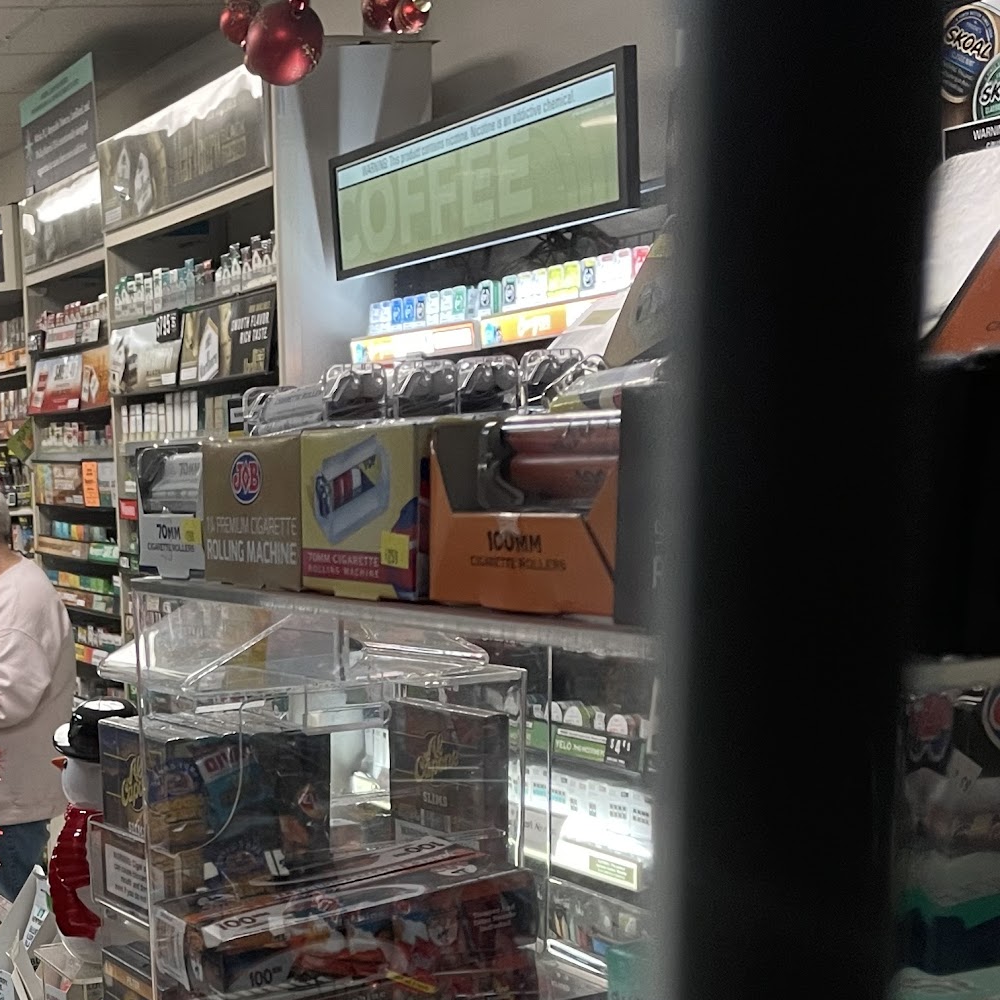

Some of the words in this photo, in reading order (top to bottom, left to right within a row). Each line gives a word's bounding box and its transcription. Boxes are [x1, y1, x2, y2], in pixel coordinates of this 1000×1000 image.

[944, 26, 992, 62] SKOAL
[231, 460, 260, 496] JOB
[156, 523, 180, 540] 70MM
[216, 517, 250, 536] PREMIUM
[250, 516, 298, 537] CIGARETTE
[206, 539, 246, 563] ROLLING
[246, 540, 298, 567] MACHINE
[307, 552, 330, 564] 70MM
[331, 553, 380, 568] CIGARETTE
[422, 791, 448, 808] SLIMS
